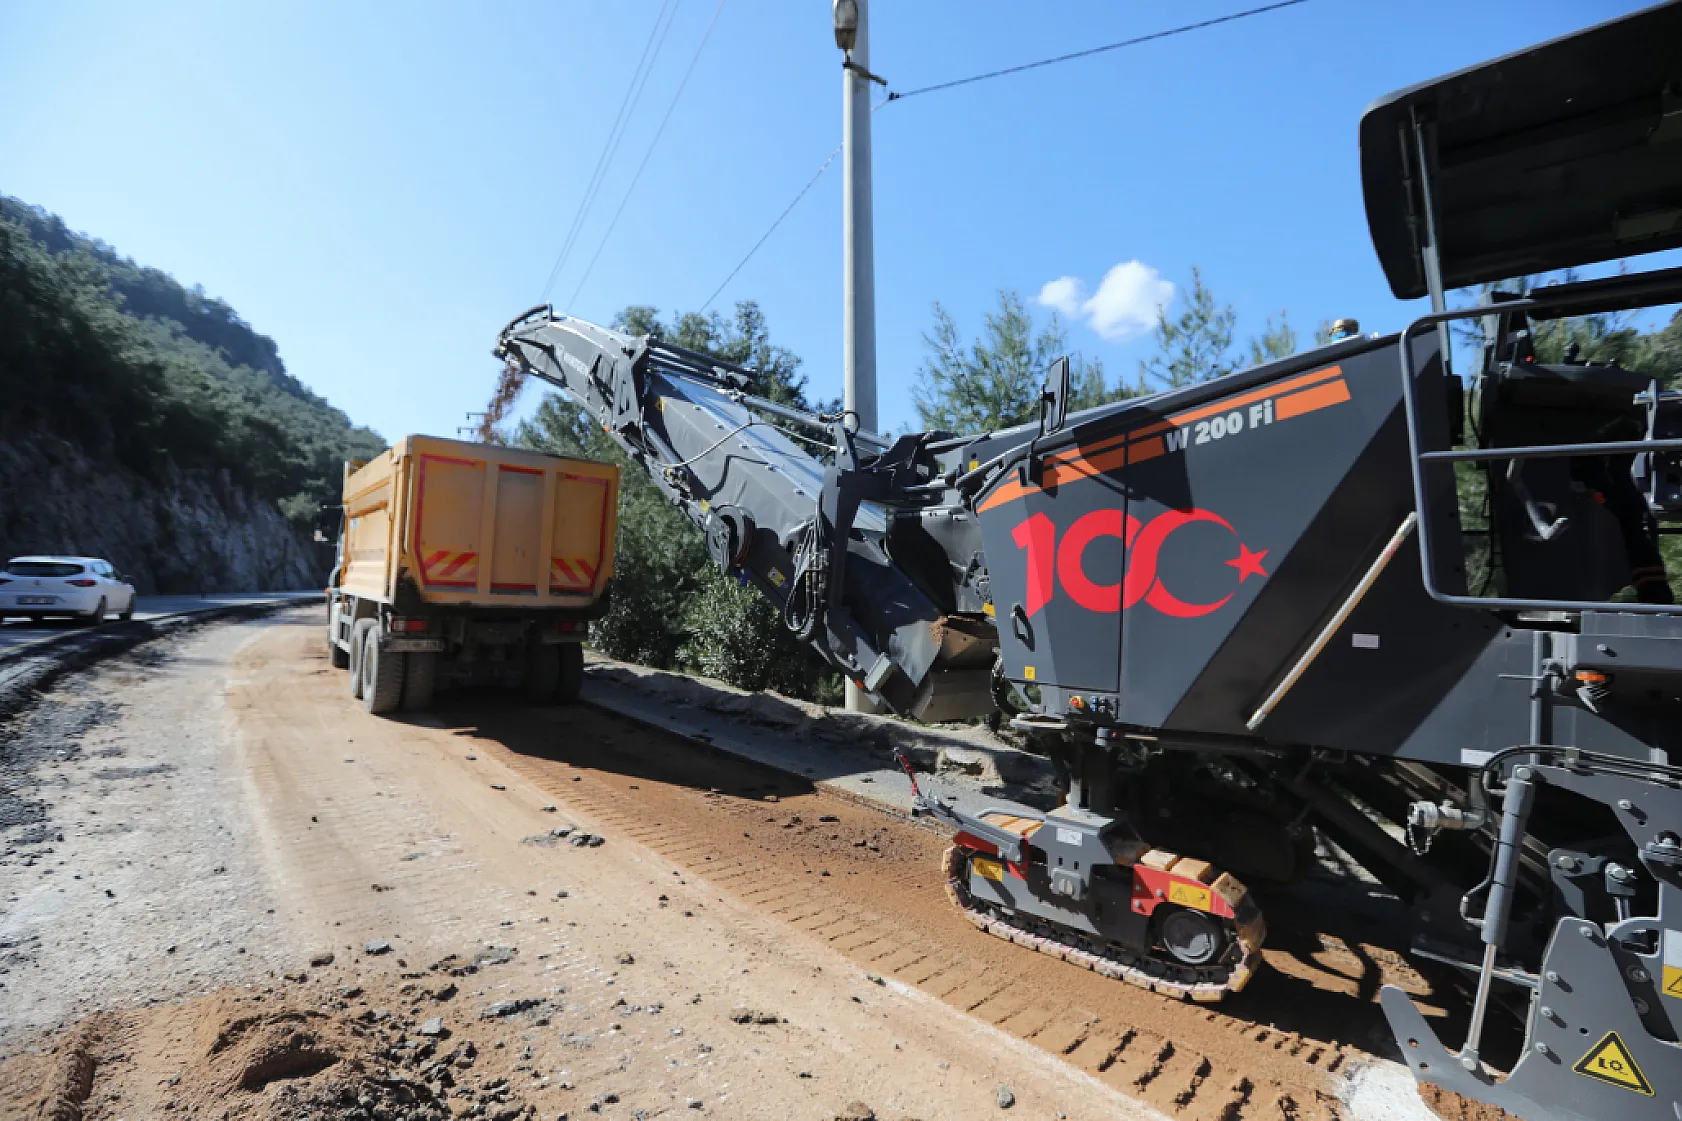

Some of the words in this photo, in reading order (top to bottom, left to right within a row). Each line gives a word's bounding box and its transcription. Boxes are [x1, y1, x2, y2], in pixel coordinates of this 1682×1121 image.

[1166, 426, 1189, 453] W
[1194, 411, 1244, 446] 200
[1248, 399, 1273, 429] Fi
